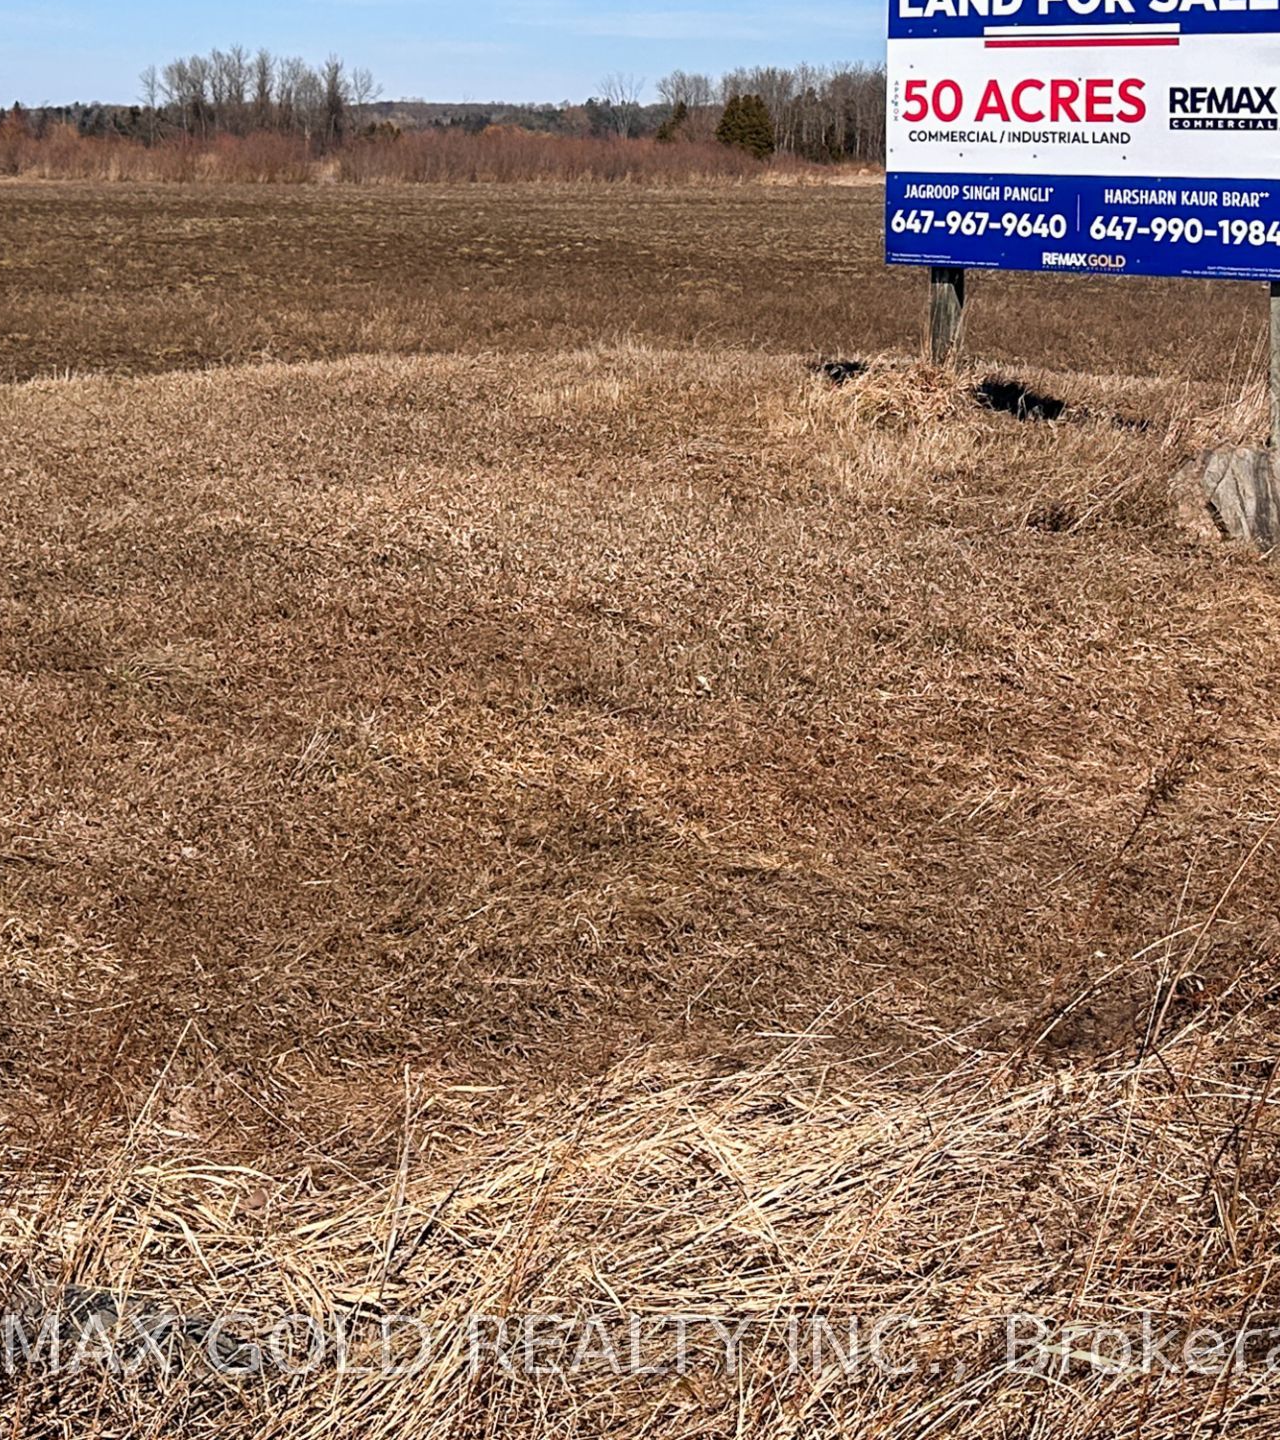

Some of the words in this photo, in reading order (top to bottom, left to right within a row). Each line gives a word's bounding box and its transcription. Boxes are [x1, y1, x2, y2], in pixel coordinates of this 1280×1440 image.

[902, 79, 963, 123] 50
[974, 78, 1146, 123] ACRES
[1172, 118, 1276, 130] COMMERCIAL
[908, 129, 997, 144] COMMERCIAL
[999, 130, 1006, 144] /
[1007, 130, 1089, 145] INDUSTRIAL
[1091, 131, 1131, 145] LAND
[904, 184, 960, 200] JAGROOP
[962, 185, 1000, 201] SINGH
[1104, 188, 1178, 206] HARSHARN
[1181, 190, 1218, 207] KAUR
[891, 209, 1067, 240] 647-967-9640
[1088, 254, 1126, 268] GOLD
